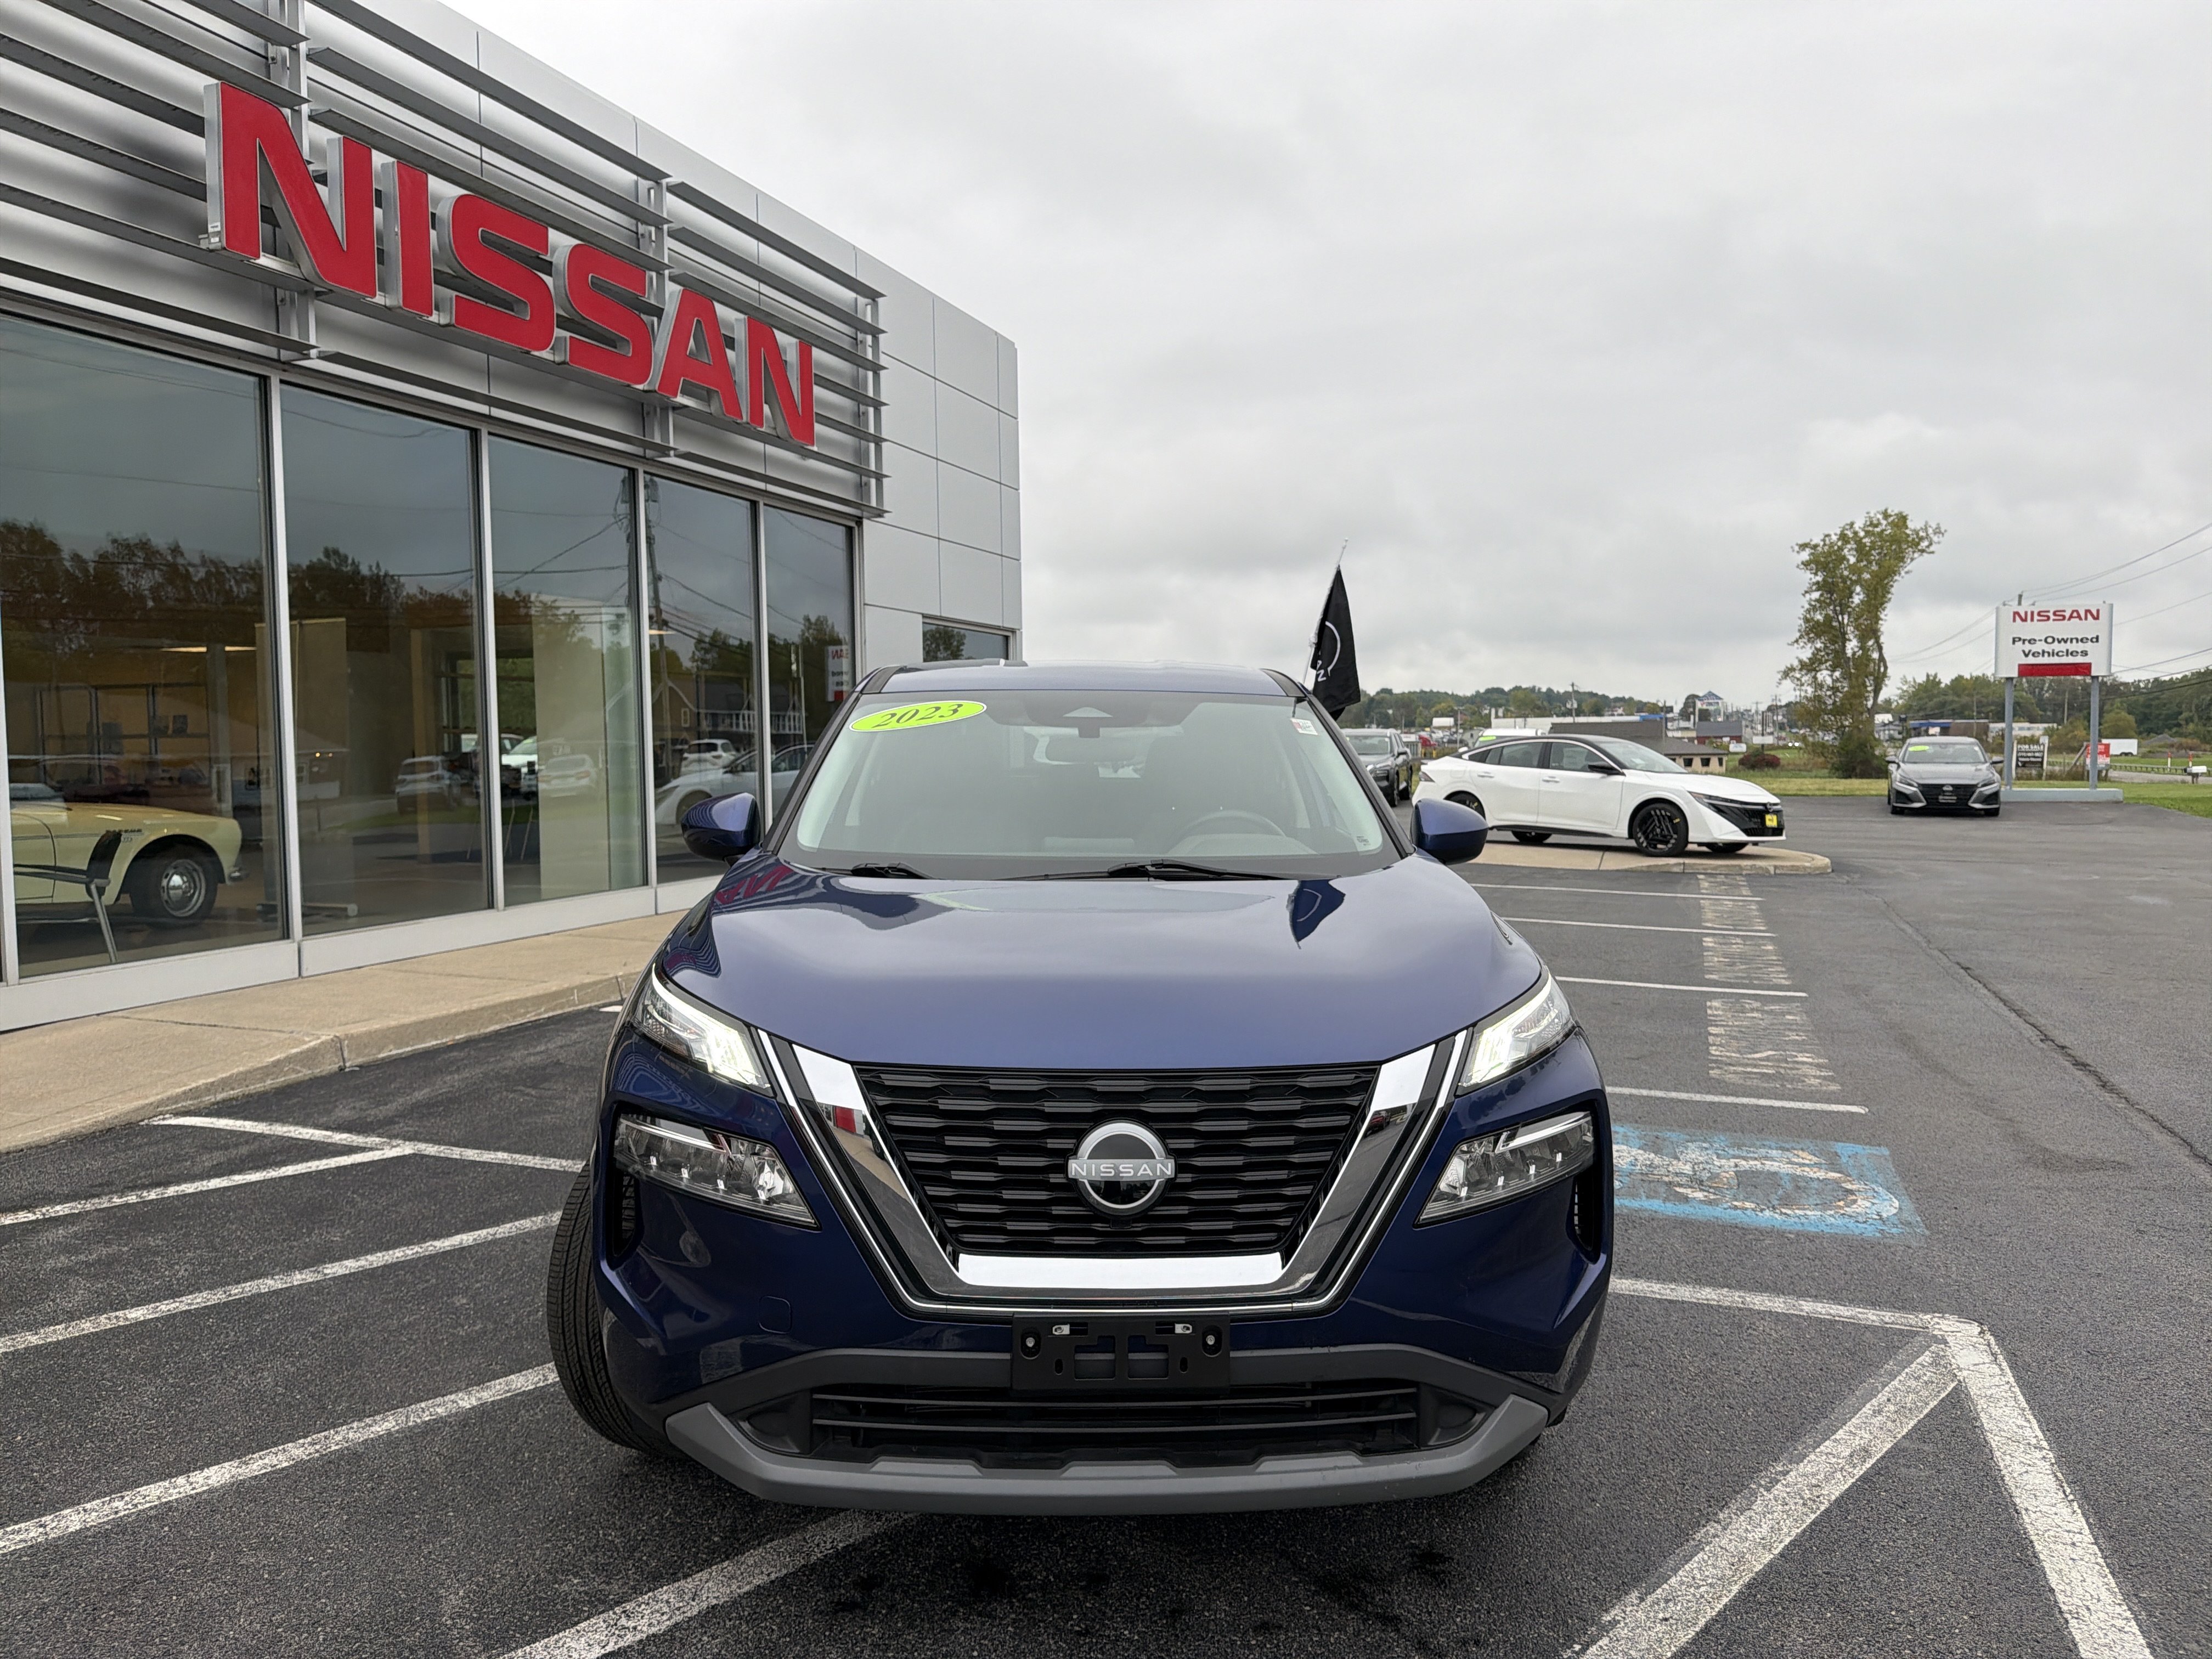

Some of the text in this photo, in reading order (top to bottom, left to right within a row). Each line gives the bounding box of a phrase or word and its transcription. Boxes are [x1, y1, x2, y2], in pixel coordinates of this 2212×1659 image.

[218, 81, 815, 447] NISSAN
[2012, 608, 2100, 623] NISSAN
[2012, 635, 2100, 645] Pre-Owned
[2021, 648, 2089, 658] Vehicles
[871, 703, 964, 729] 2023
[1071, 1163, 1171, 1177] NISSAN
